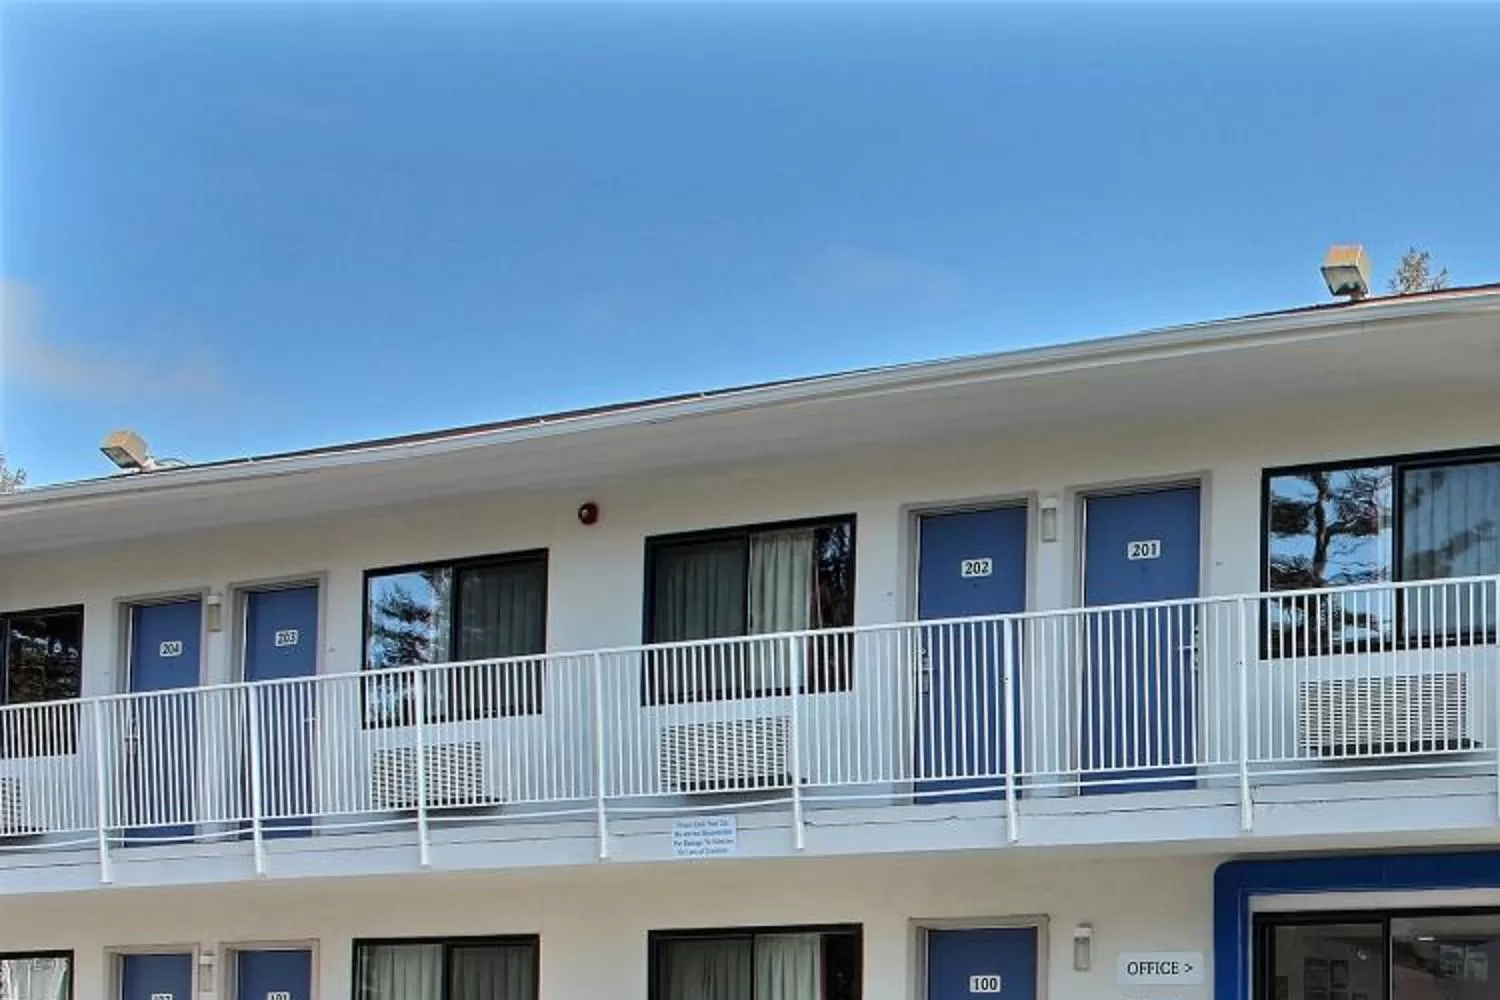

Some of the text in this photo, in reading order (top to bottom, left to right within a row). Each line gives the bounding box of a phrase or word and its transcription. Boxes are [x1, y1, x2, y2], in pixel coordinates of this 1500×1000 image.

[1131, 543, 1157, 556] 201
[965, 561, 989, 574] 202
[278, 633, 296, 645] 203
[162, 643, 180, 655] 204
[1127, 961, 1179, 976] OFFICE
[974, 978, 997, 991] 100
